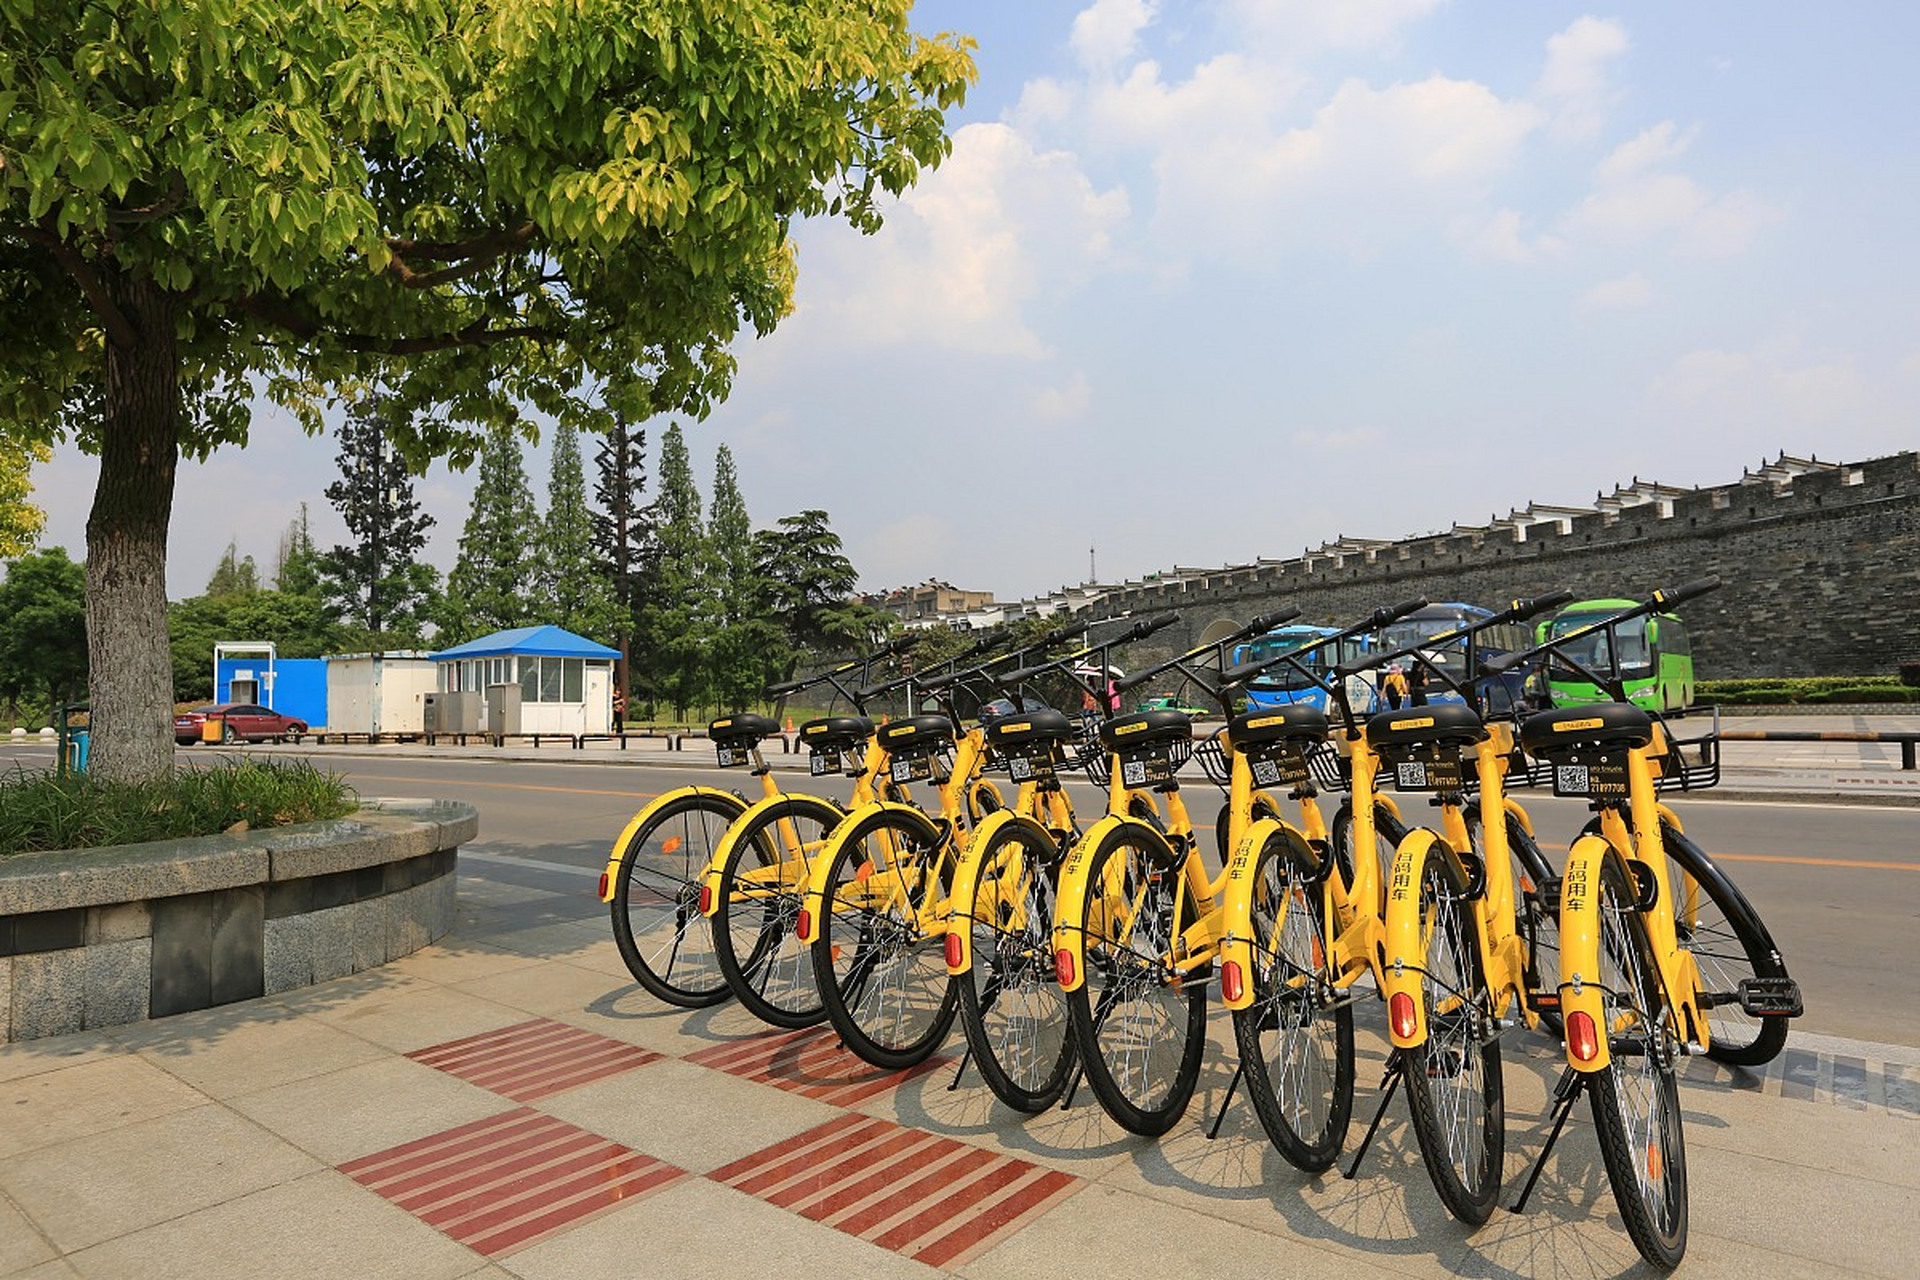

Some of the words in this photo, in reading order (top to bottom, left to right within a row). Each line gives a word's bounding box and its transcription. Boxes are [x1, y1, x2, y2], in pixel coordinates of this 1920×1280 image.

[1391, 852, 1414, 902] 扫码用车
[1566, 860, 1588, 912] 扫码用车
